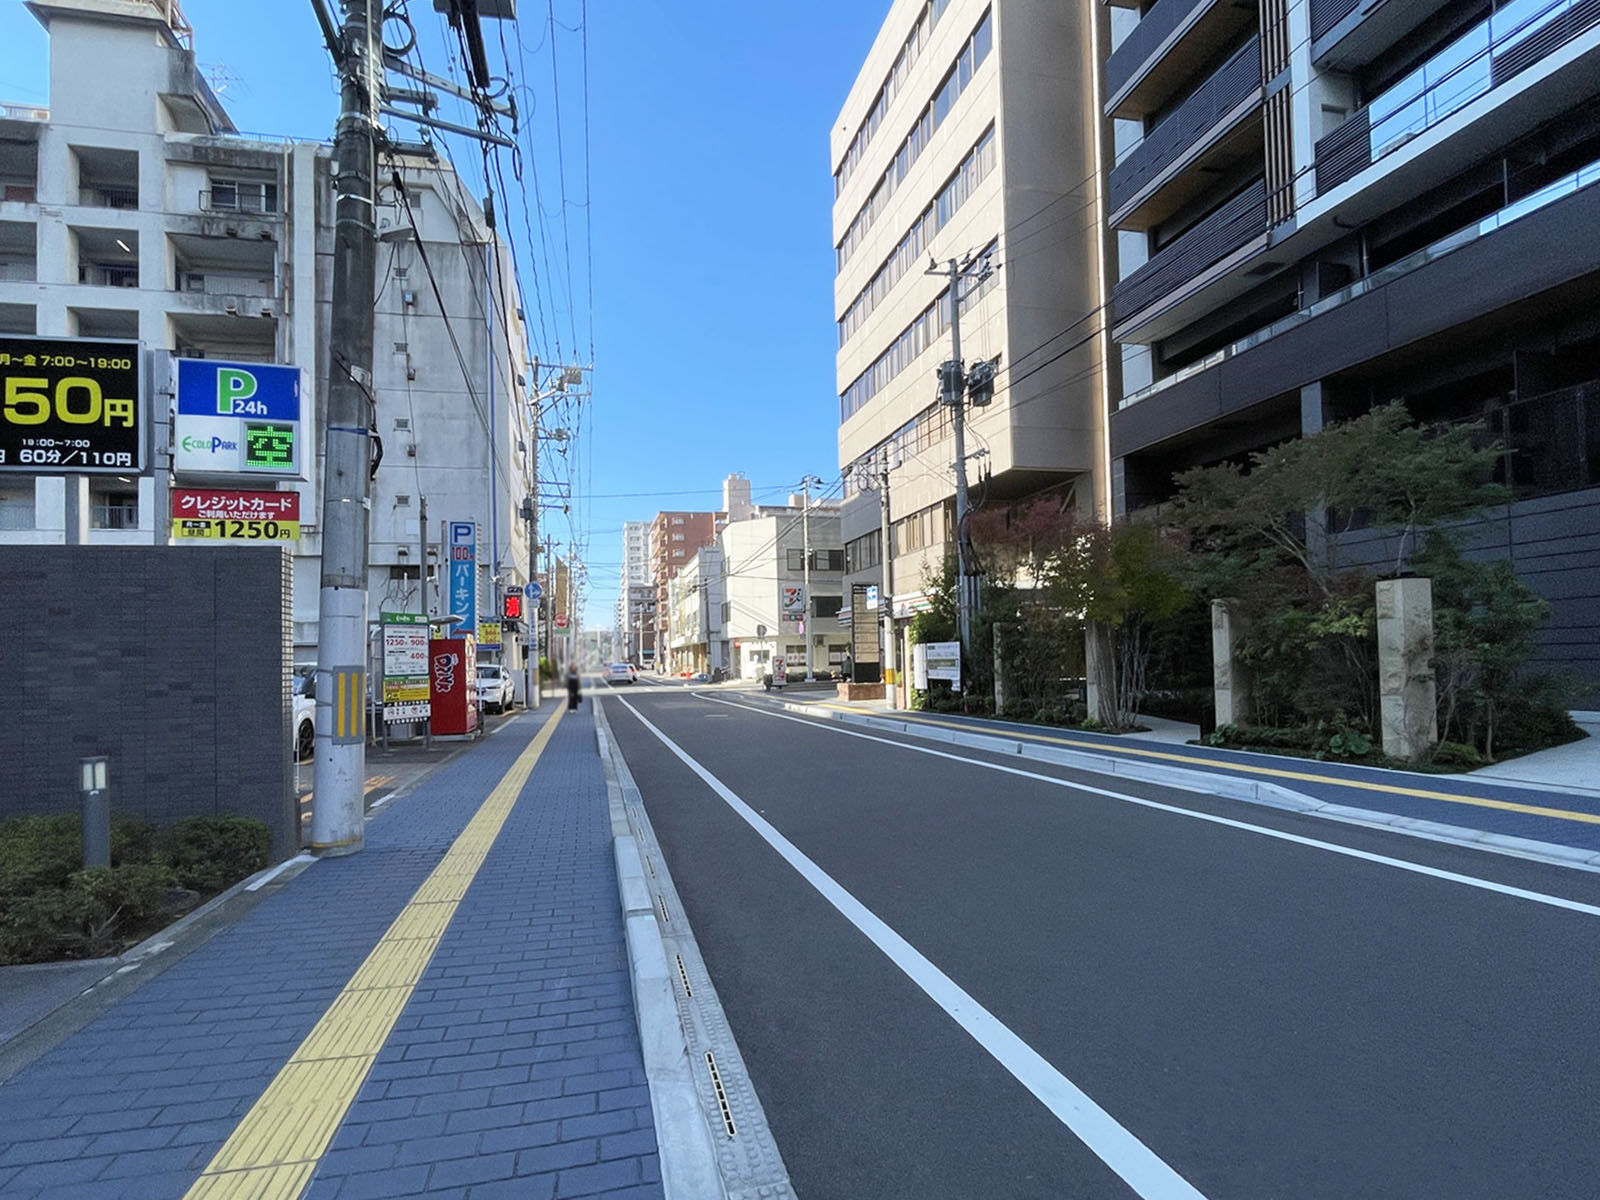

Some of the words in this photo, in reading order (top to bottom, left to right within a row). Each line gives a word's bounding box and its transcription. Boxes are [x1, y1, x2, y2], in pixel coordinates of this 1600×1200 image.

[40, 355, 131, 369] 7:00～19:00
[217, 367, 257, 414] P
[234, 400, 268, 415] 24h
[247, 426, 293, 468] 空
[181, 496, 292, 511] クレジットカード
[198, 510, 275, 519] ご利用いただけます
[214, 520, 290, 539] 1250円
[454, 525, 471, 543] P
